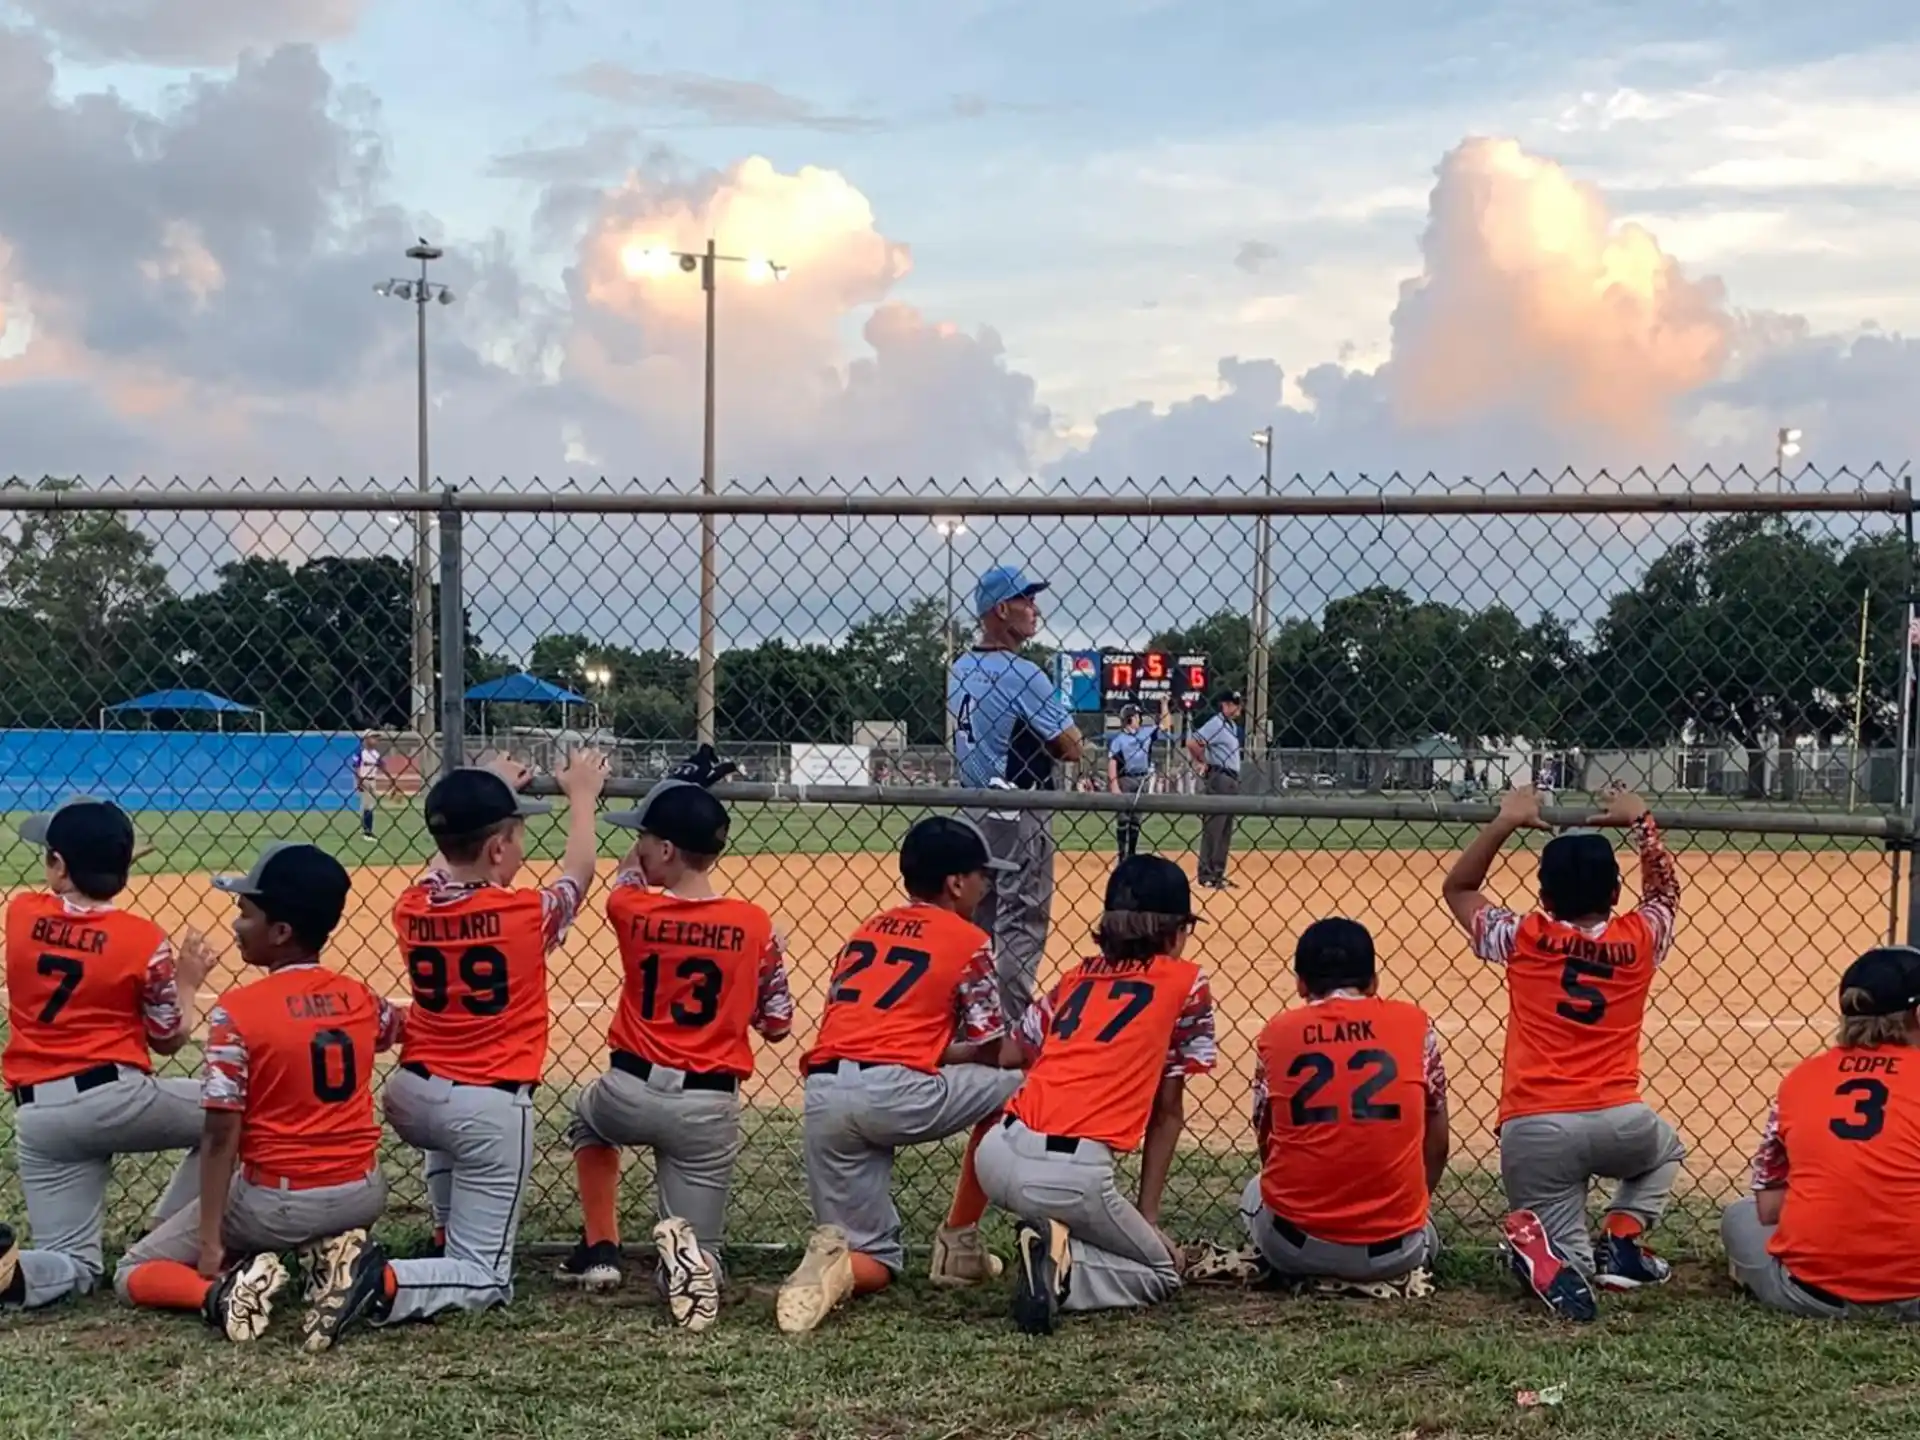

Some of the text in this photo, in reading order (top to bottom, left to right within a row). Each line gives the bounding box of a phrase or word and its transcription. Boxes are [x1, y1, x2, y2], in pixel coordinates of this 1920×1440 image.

[1112, 665, 1132, 687] 17
[1148, 654, 1163, 678] 5
[1190, 667, 1205, 688] 6
[1105, 690, 1131, 700] BALL
[957, 693, 976, 744] 4
[31, 917, 108, 955] BEILER
[408, 912, 501, 941] POLLARD
[631, 914, 746, 952] FLETCHER
[864, 915, 932, 938] FRERE
[37, 953, 84, 1024] 7
[408, 945, 510, 1016] 99
[640, 953, 724, 1028] 13
[832, 940, 932, 1010] 27
[1555, 957, 1615, 1025] 5
[285, 991, 350, 1019] CAREY
[1051, 979, 1155, 1043] 47
[1303, 1019, 1377, 1046] CLARK
[310, 1027, 357, 1103] 0
[1838, 1055, 1904, 1075] COPE
[1286, 1048, 1402, 1126] 22
[1828, 1077, 1890, 1142] 3
